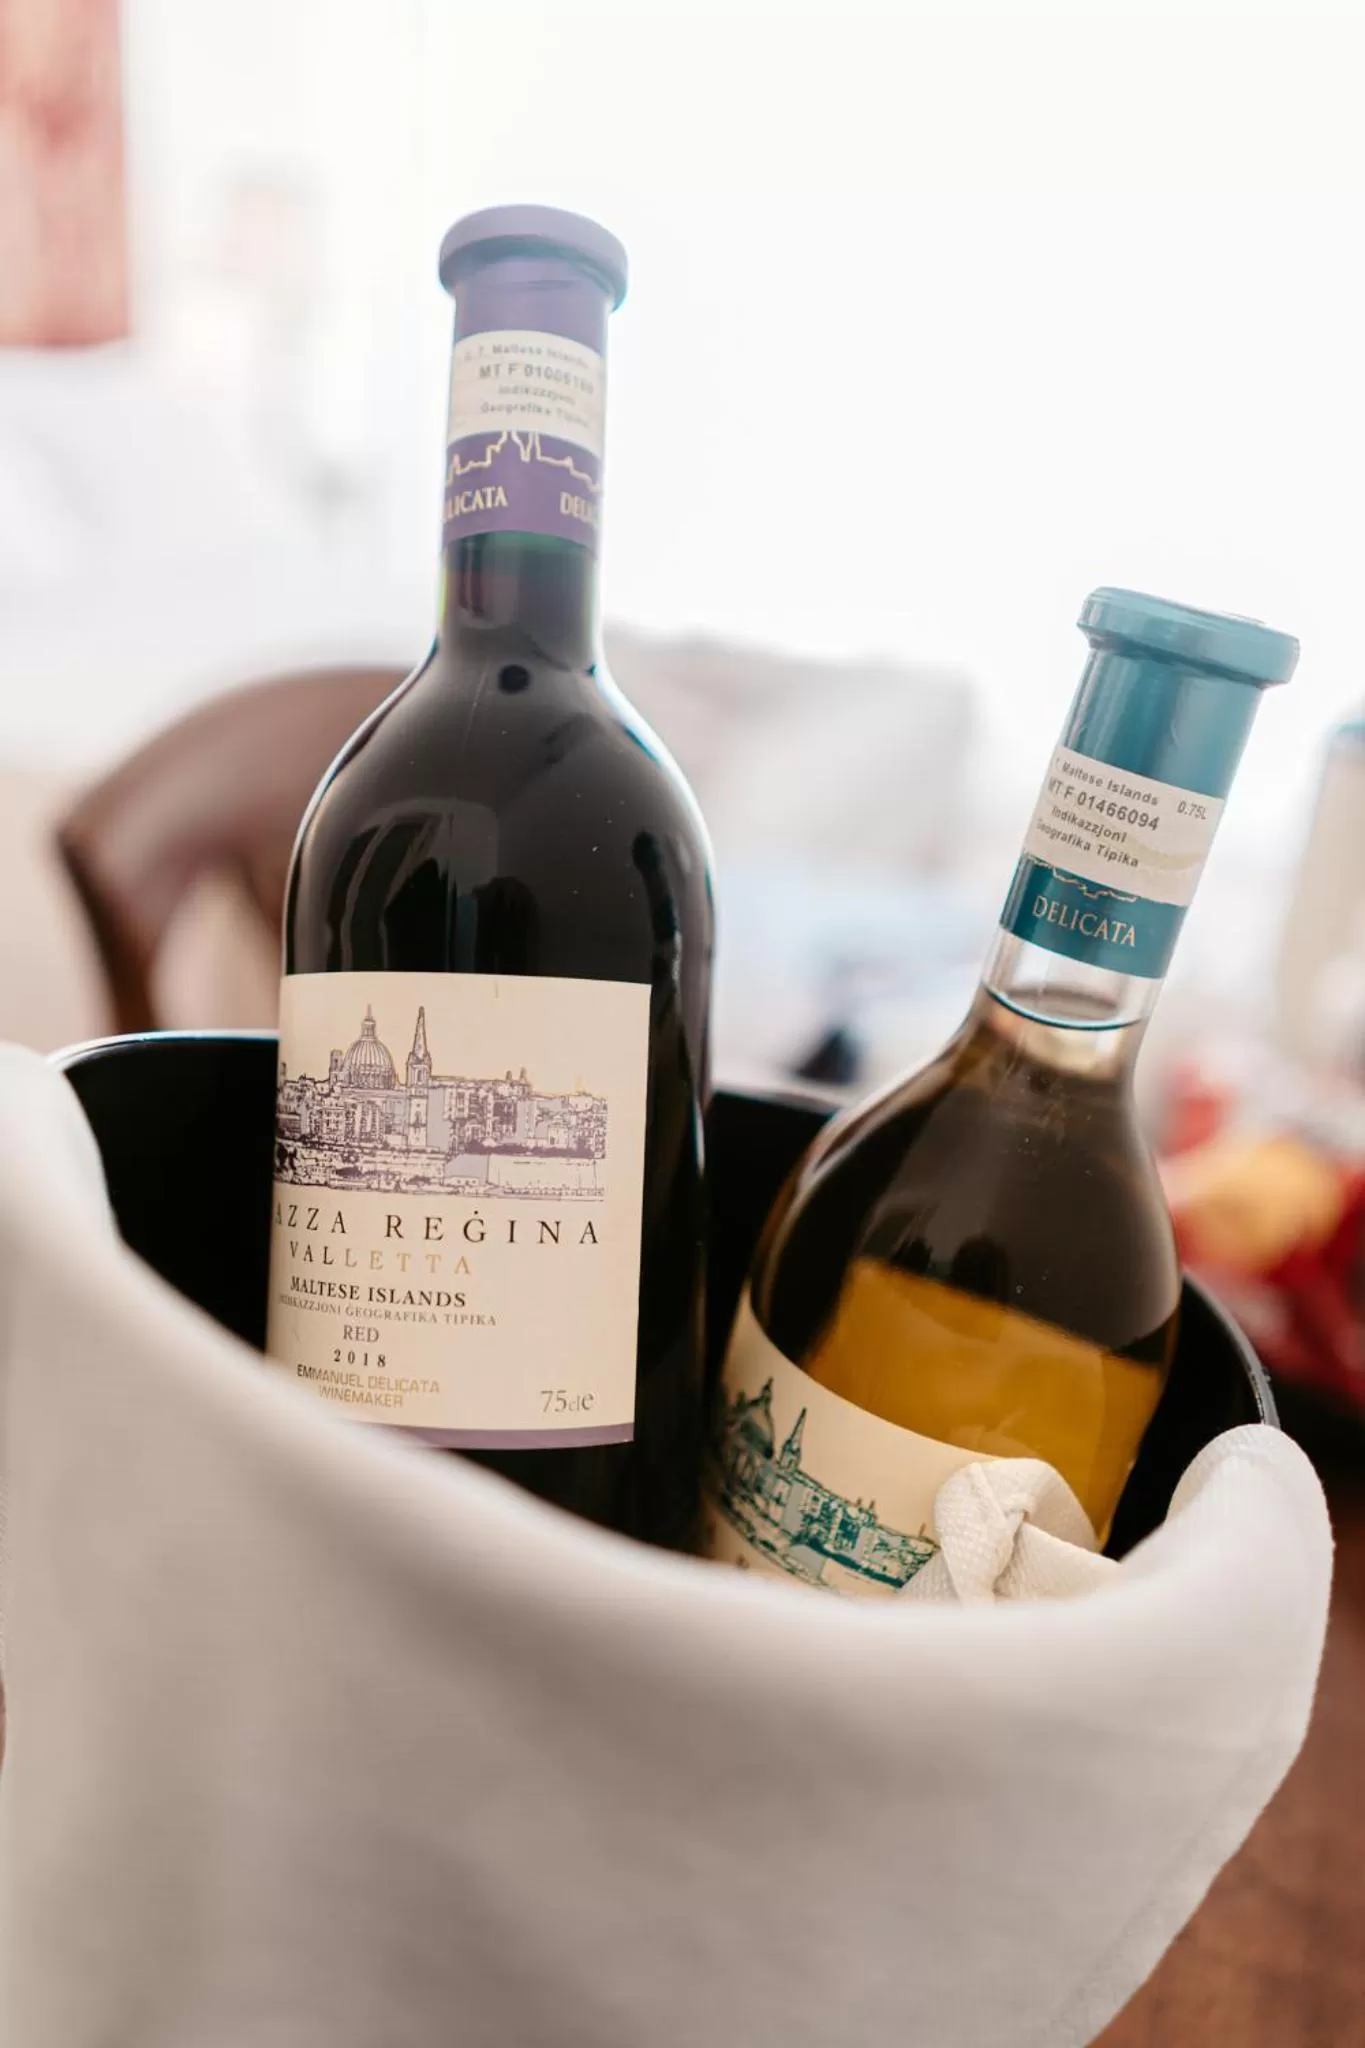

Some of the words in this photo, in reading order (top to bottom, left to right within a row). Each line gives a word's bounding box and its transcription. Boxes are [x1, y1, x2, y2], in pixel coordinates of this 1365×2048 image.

[479, 363, 502, 379] MT
[507, 363, 518, 376] F
[1107, 779, 1158, 806] Islands
[1064, 786, 1075, 799] F
[1077, 791, 1160, 831] 01466094
[1177, 800, 1207, 820] 0.75L
[1051, 806, 1128, 843] Indikazzjoni
[1096, 844, 1139, 868] Tipika
[1032, 895, 1136, 947] DELICATA
[289, 1240, 472, 1275] VALLETTA
[290, 1275, 360, 1300] MALTESE
[368, 1286, 467, 1308] ISLANDS
[443, 1312, 497, 1326] TIPIKA
[343, 1324, 380, 1343] RED
[333, 1349, 387, 1368] 2018
[296, 1363, 364, 1388] EMMANUEL
[367, 1375, 441, 1394] DELICATA
[319, 1384, 403, 1408] WINEMAKER
